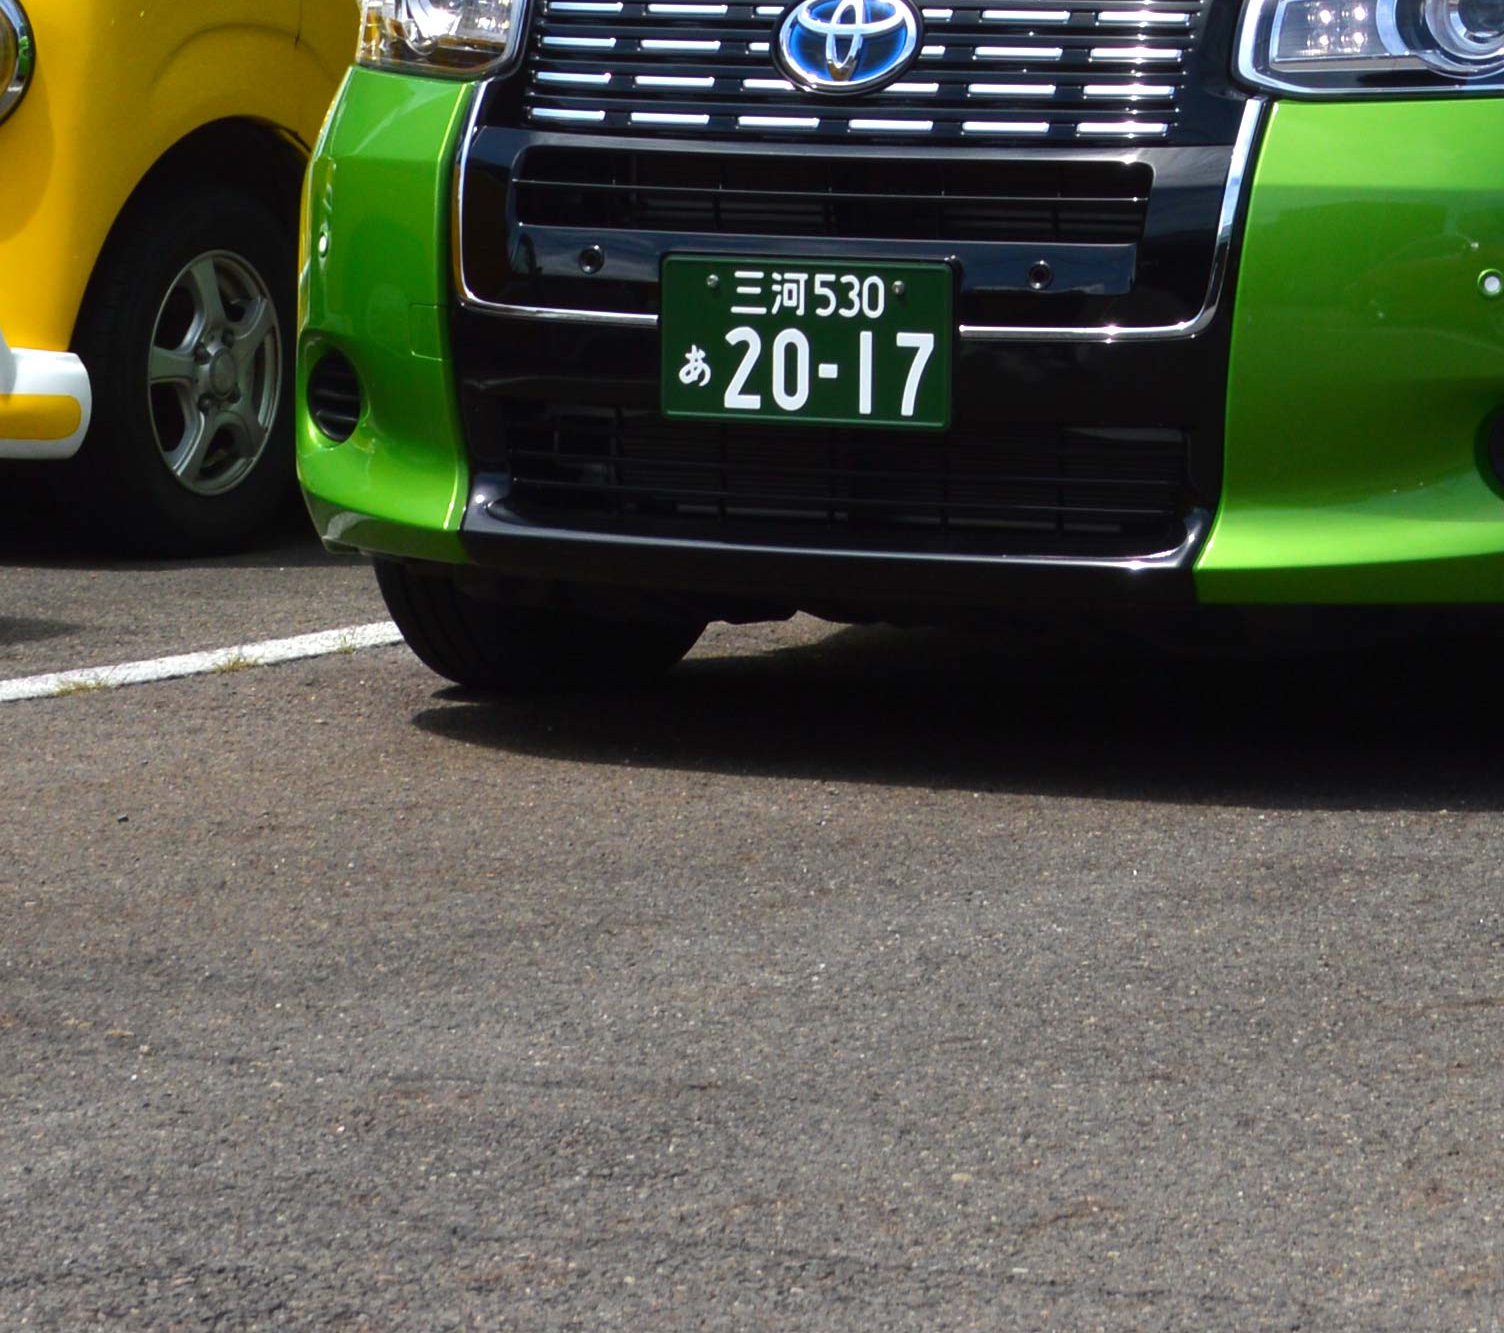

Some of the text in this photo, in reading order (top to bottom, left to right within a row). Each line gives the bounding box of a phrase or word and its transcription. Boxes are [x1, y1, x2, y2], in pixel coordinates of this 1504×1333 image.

[731, 271, 885, 319] 三河 530
[678, 326, 935, 417] あ 20-17
